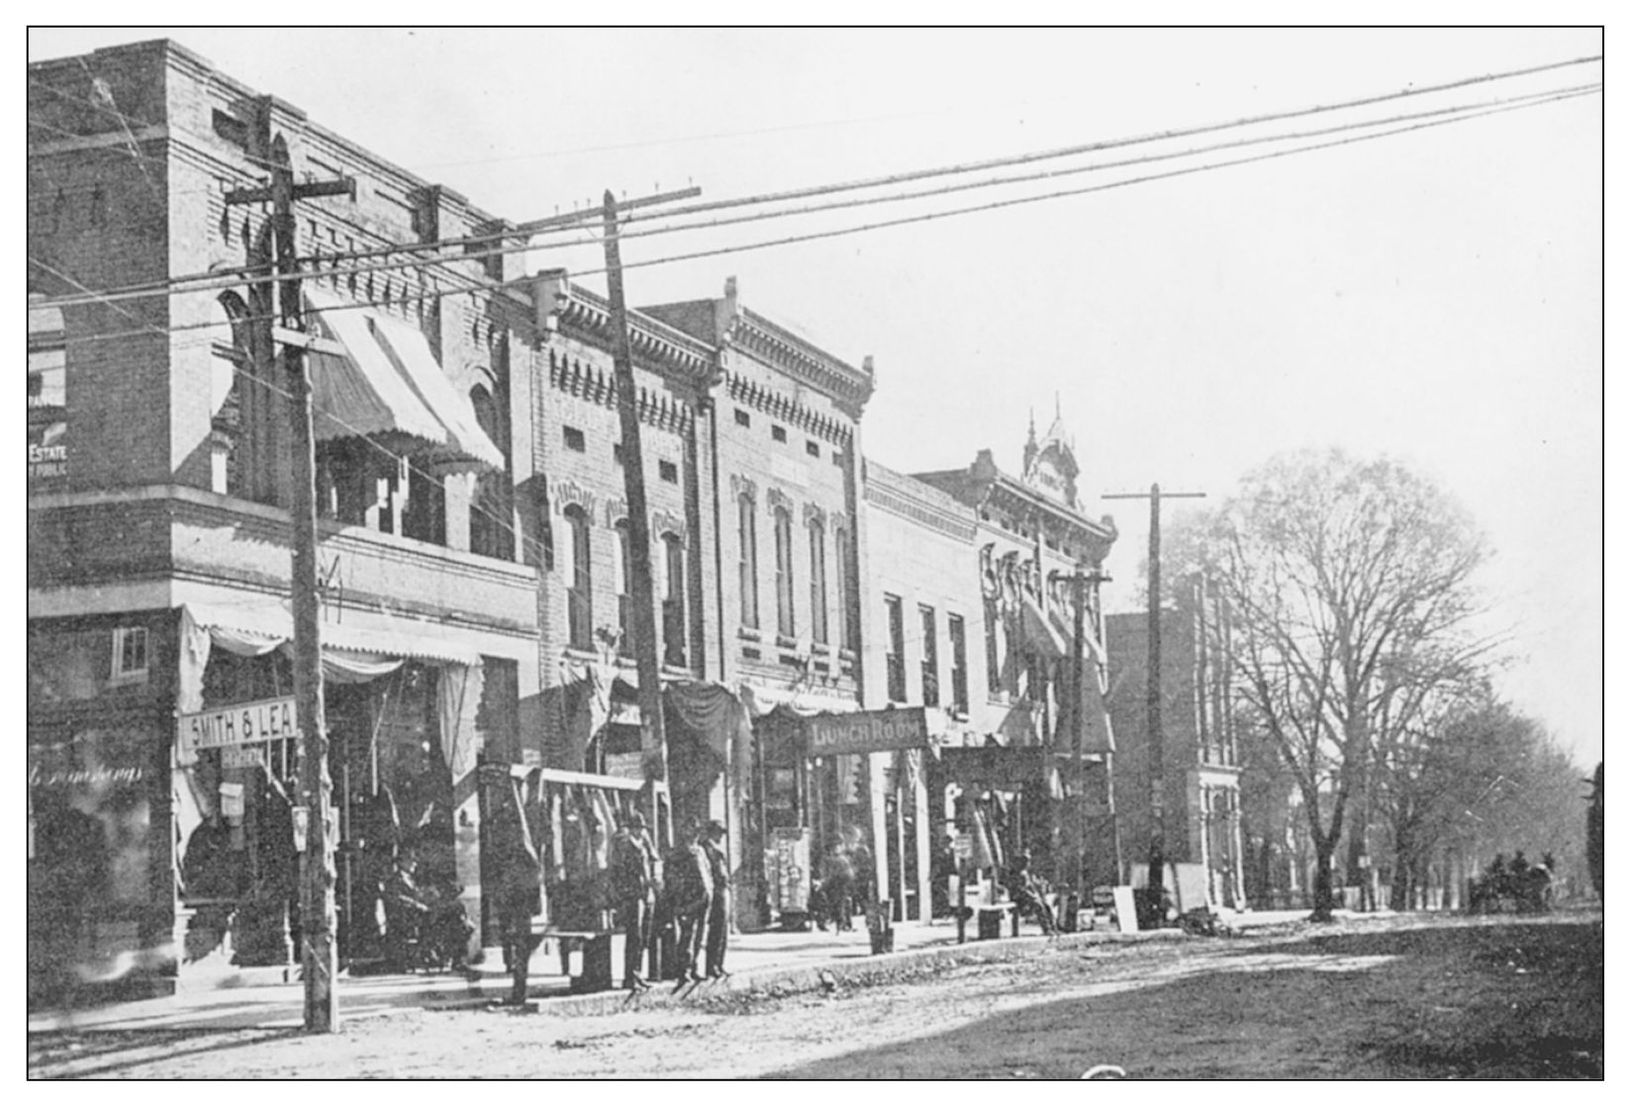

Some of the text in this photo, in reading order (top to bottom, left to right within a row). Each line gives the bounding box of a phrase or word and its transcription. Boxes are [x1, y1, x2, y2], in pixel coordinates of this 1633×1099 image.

[192, 710, 236, 747] SMITH
[242, 710, 253, 740] &
[811, 718, 920, 746] LUNCH ROOM
